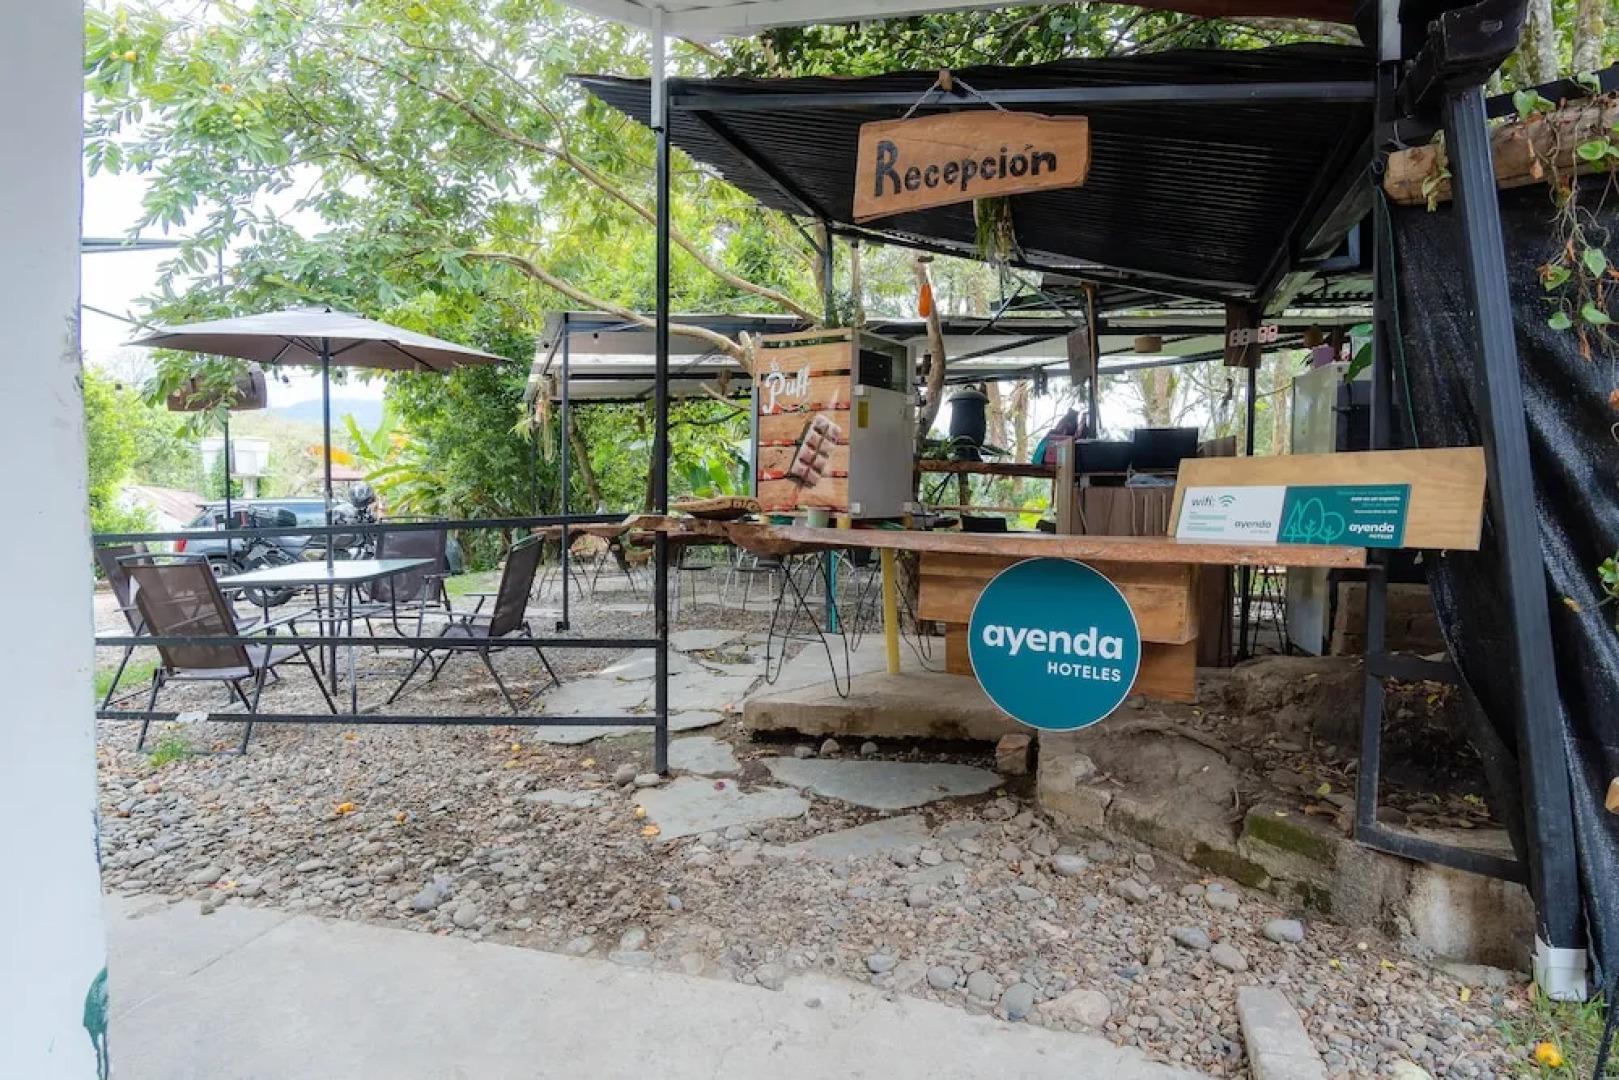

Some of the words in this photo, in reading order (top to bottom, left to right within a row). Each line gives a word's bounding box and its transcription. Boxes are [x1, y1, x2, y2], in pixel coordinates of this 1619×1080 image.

[874, 139, 1057, 197] Recepción
[1234, 519, 1272, 529] ayenda
[1348, 522, 1395, 535] ayenda
[982, 623, 1124, 660] ayenda
[1046, 661, 1122, 683] HOTELES
